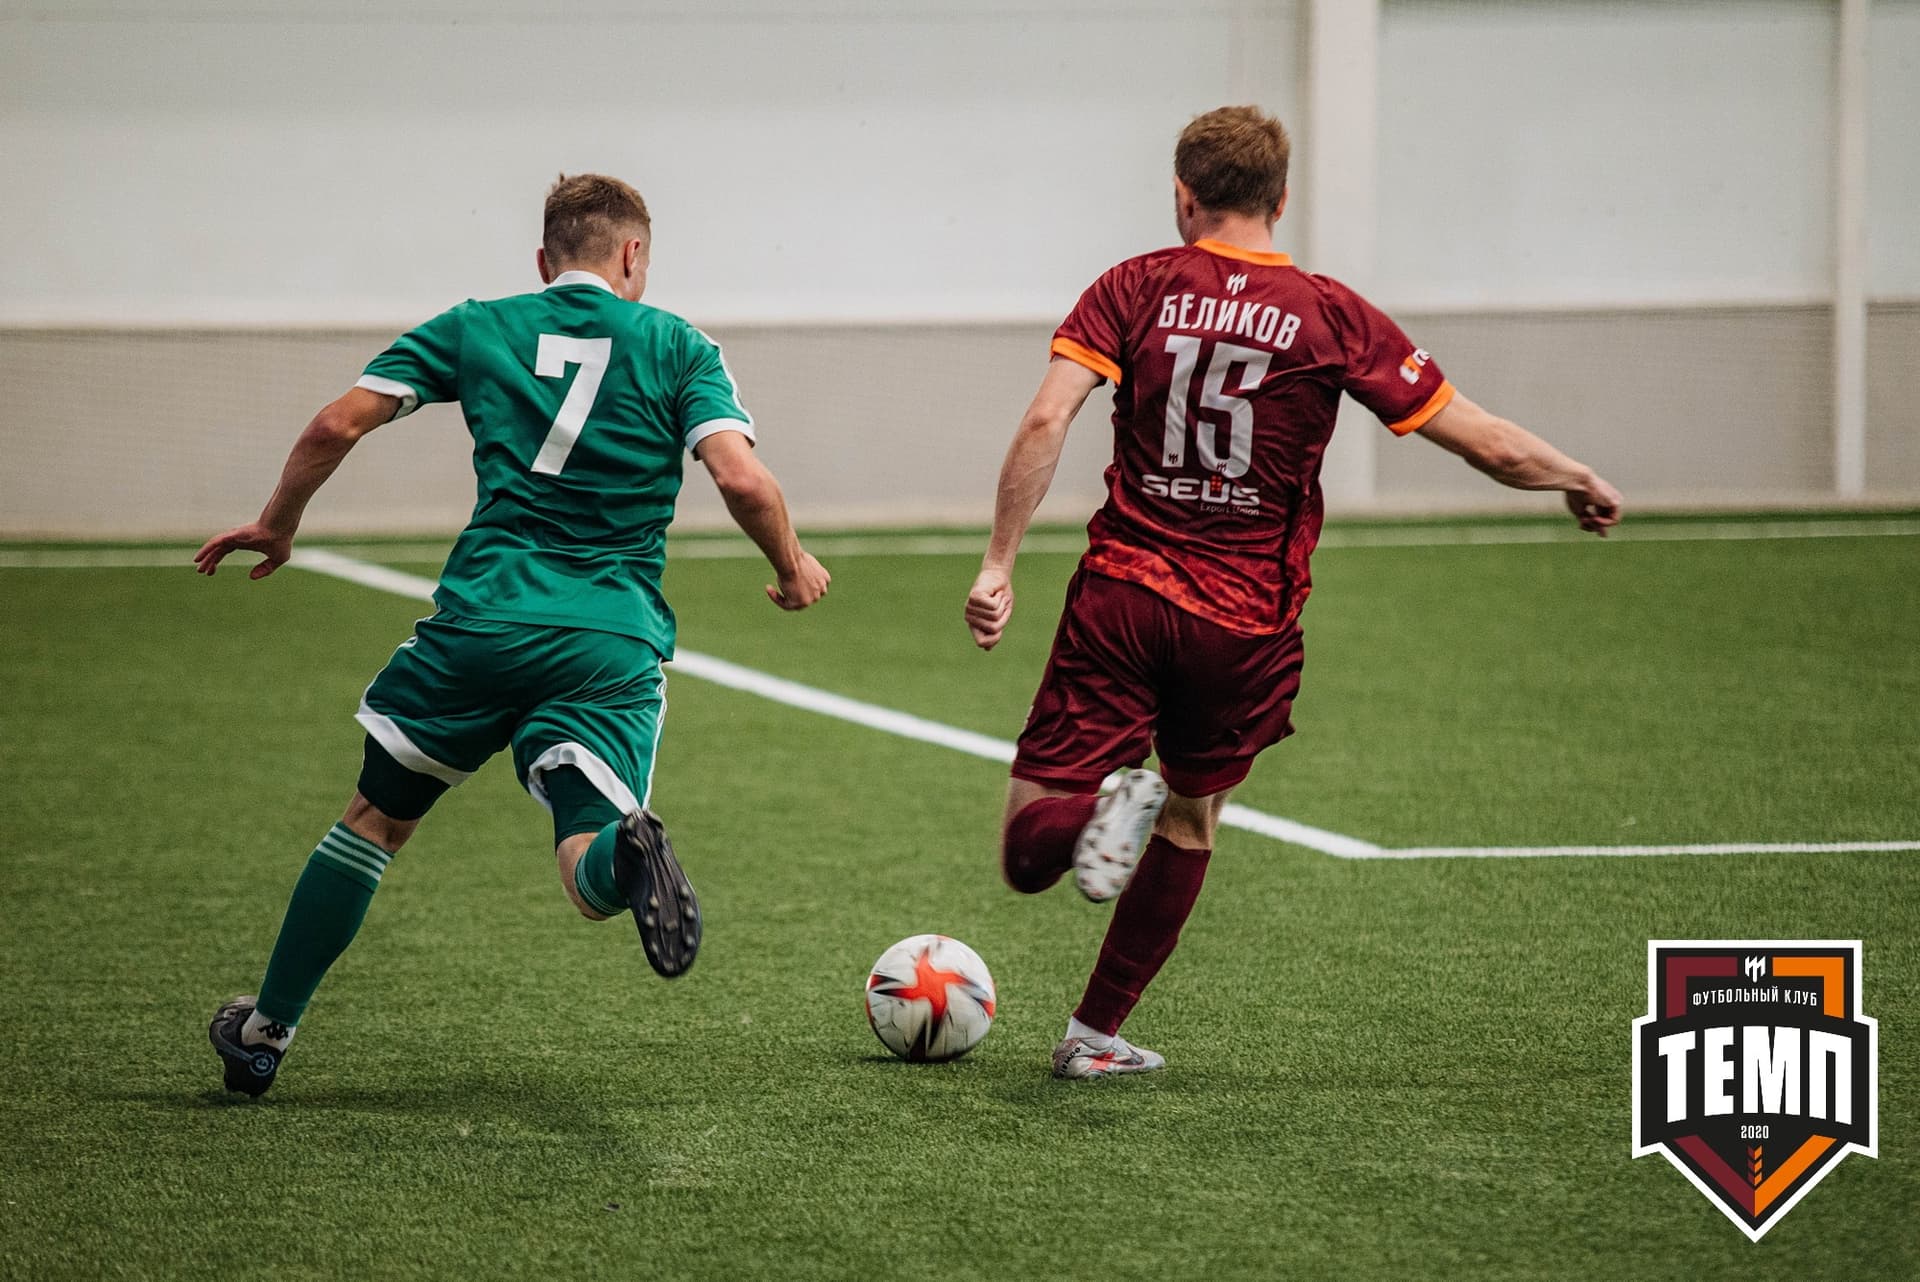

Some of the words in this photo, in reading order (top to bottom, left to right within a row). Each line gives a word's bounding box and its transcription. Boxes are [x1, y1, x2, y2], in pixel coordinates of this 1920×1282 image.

[1157, 293, 1302, 350] БЕЛИКОВ
[530, 333, 612, 475] 7
[1162, 334, 1273, 479] 15
[1141, 474, 1260, 506] SEUS
